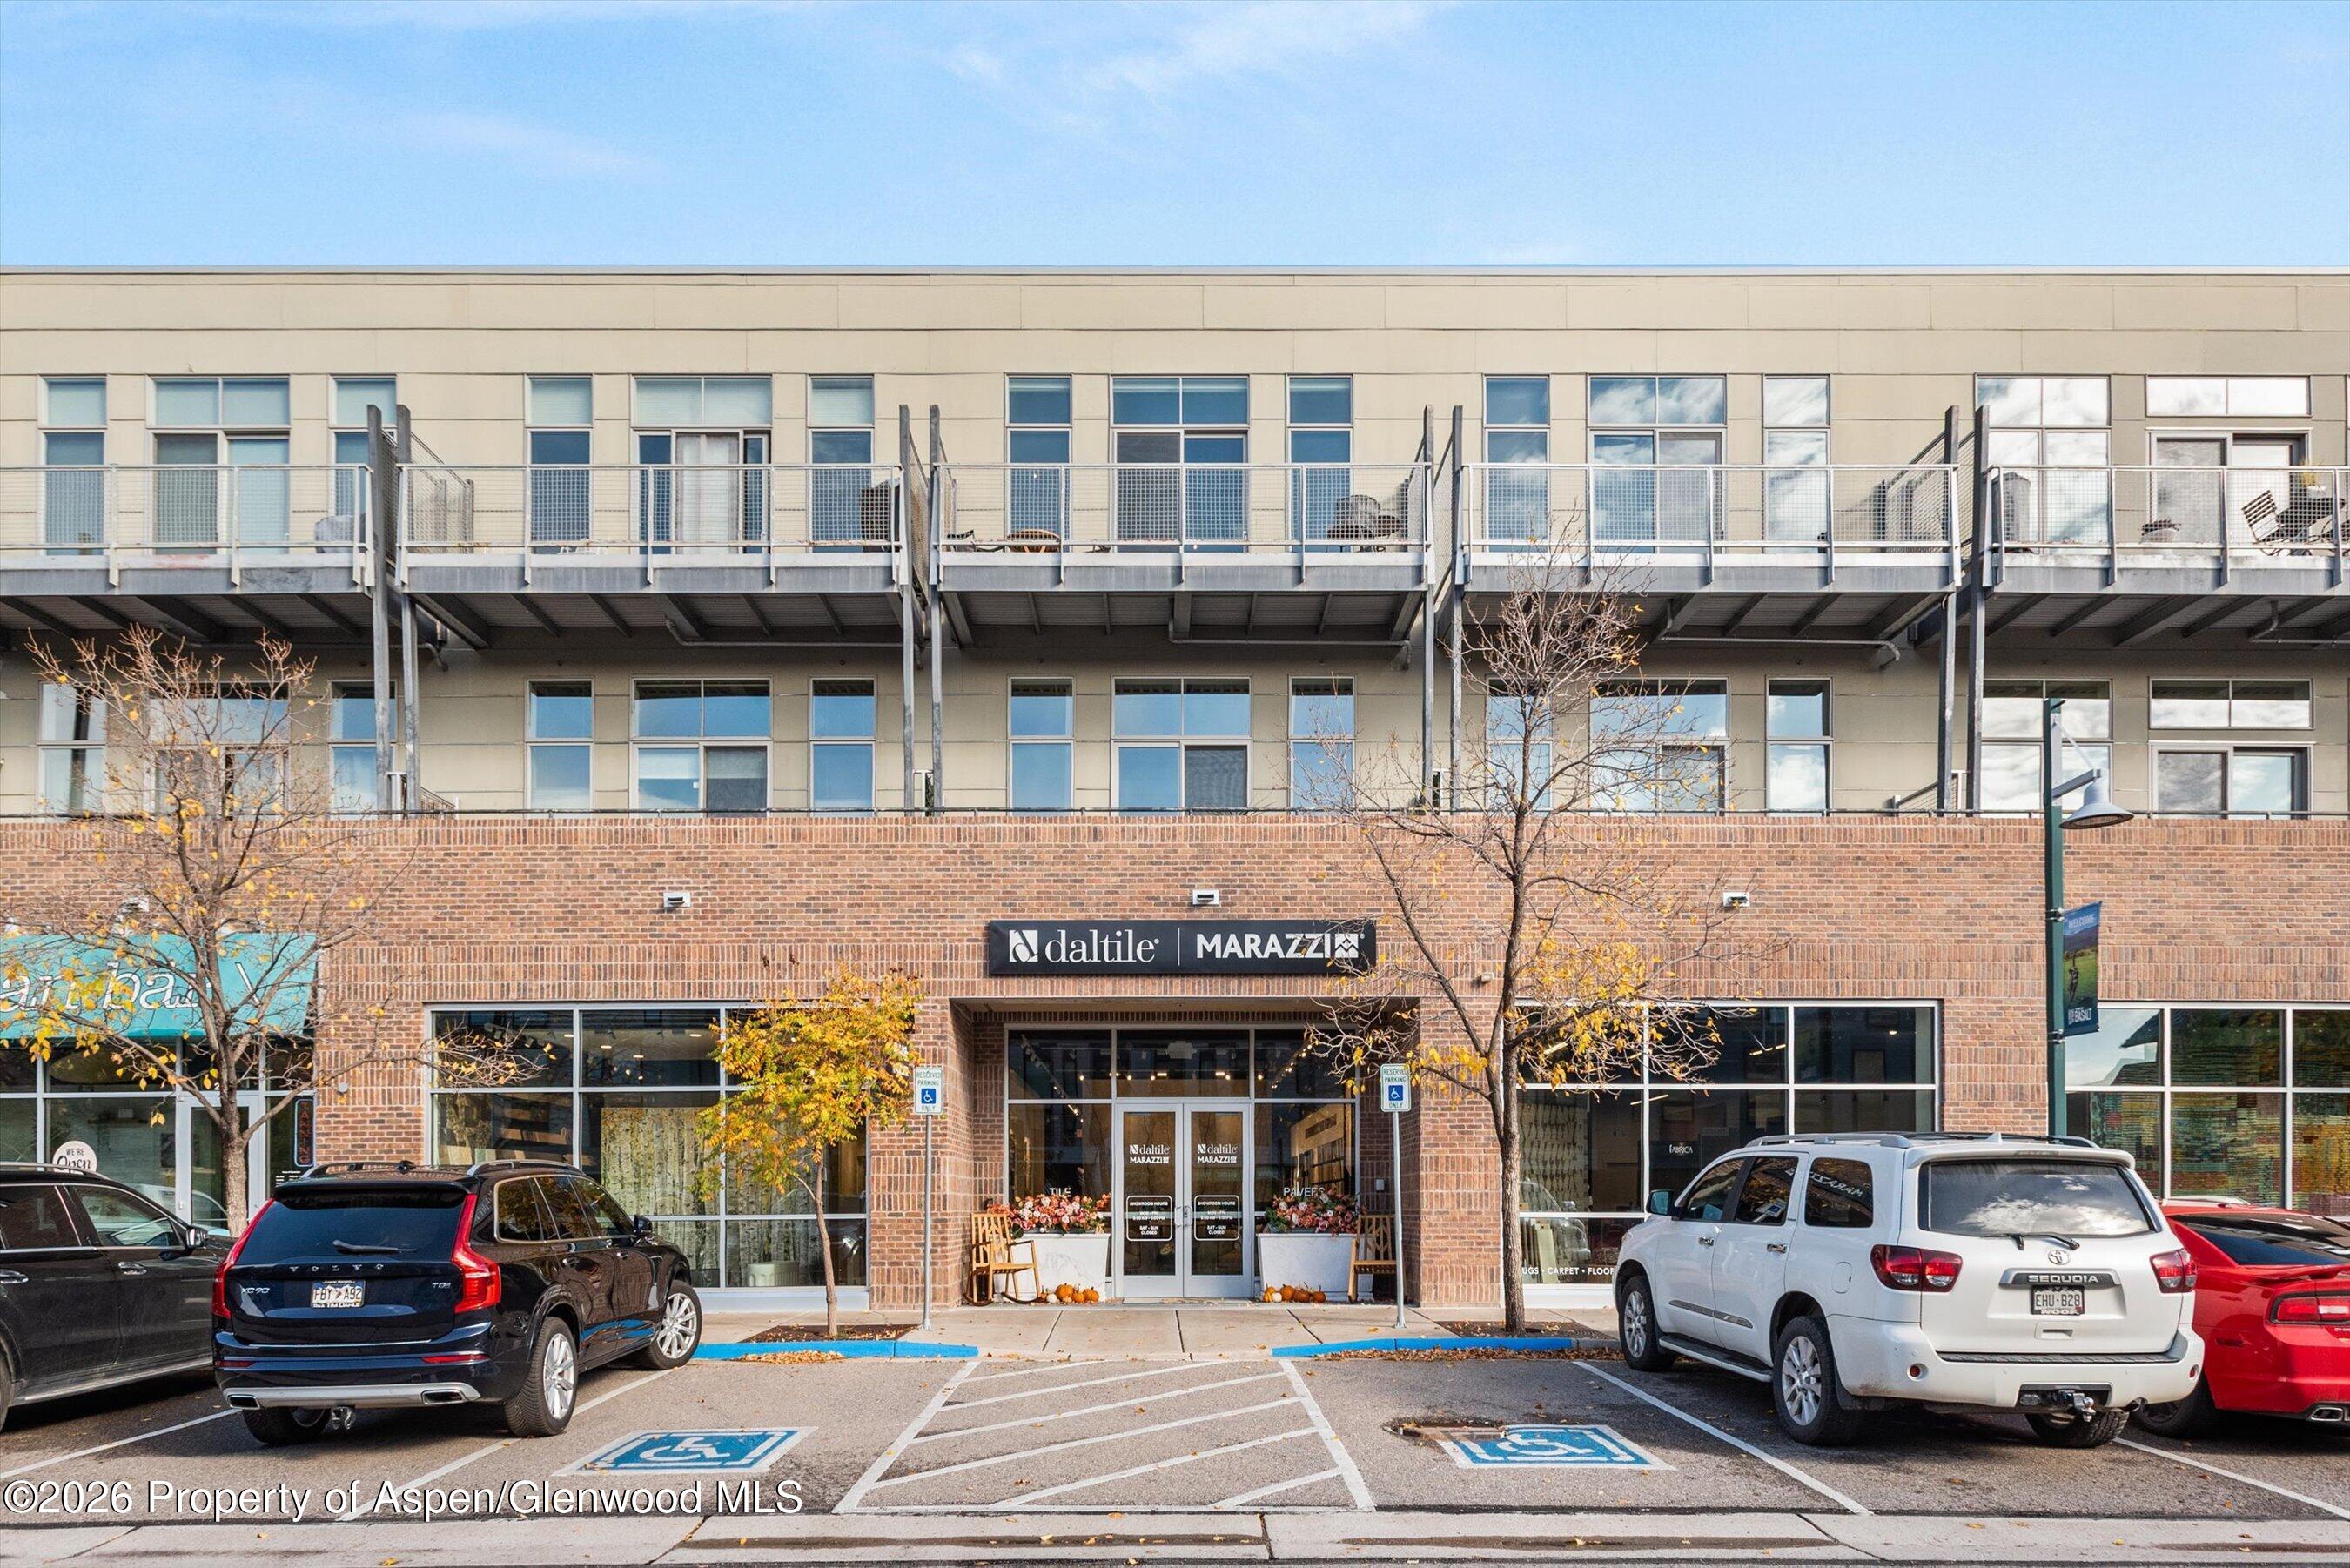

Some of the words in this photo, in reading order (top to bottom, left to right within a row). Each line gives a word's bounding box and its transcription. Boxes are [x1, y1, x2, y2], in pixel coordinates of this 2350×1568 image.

[2068, 914, 2094, 928] WELCOME
[1197, 934, 1331, 958] MARAZZI
[299, 1102, 311, 1164] TANNING
[57, 1155, 91, 1170] Open
[1049, 1187, 1071, 1197] TILE
